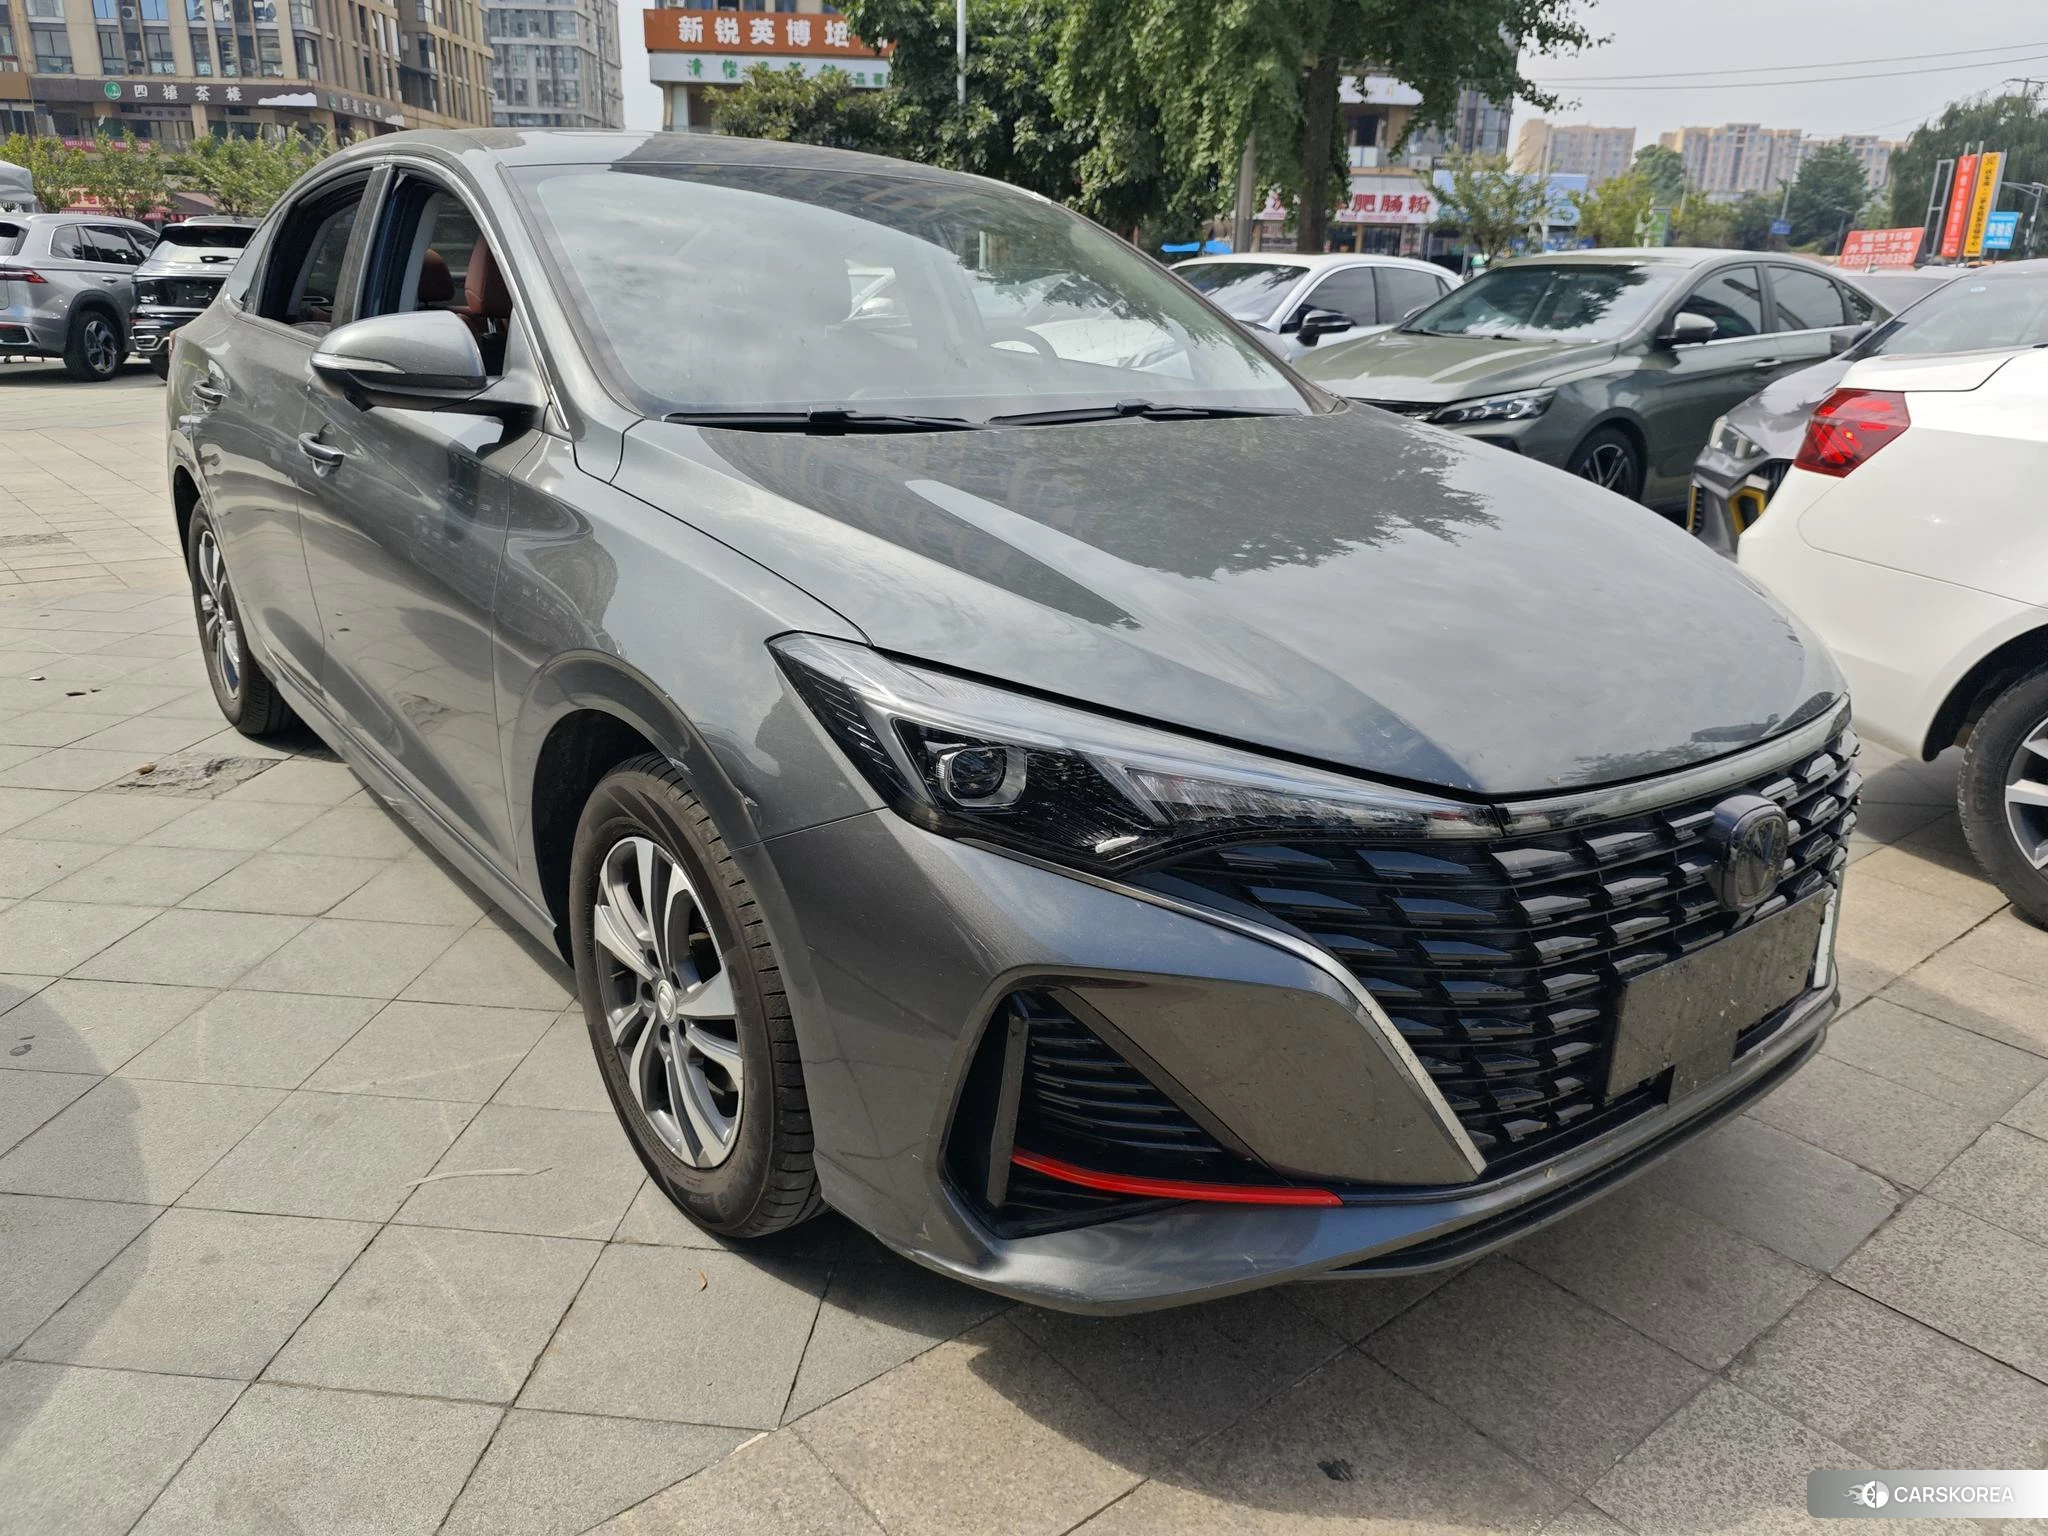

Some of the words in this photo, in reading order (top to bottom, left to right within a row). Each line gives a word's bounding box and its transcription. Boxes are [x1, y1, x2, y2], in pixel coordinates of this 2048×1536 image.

[678, 16, 888, 48] 新锐英博培
[1336, 194, 1430, 214] 肥肠粉
